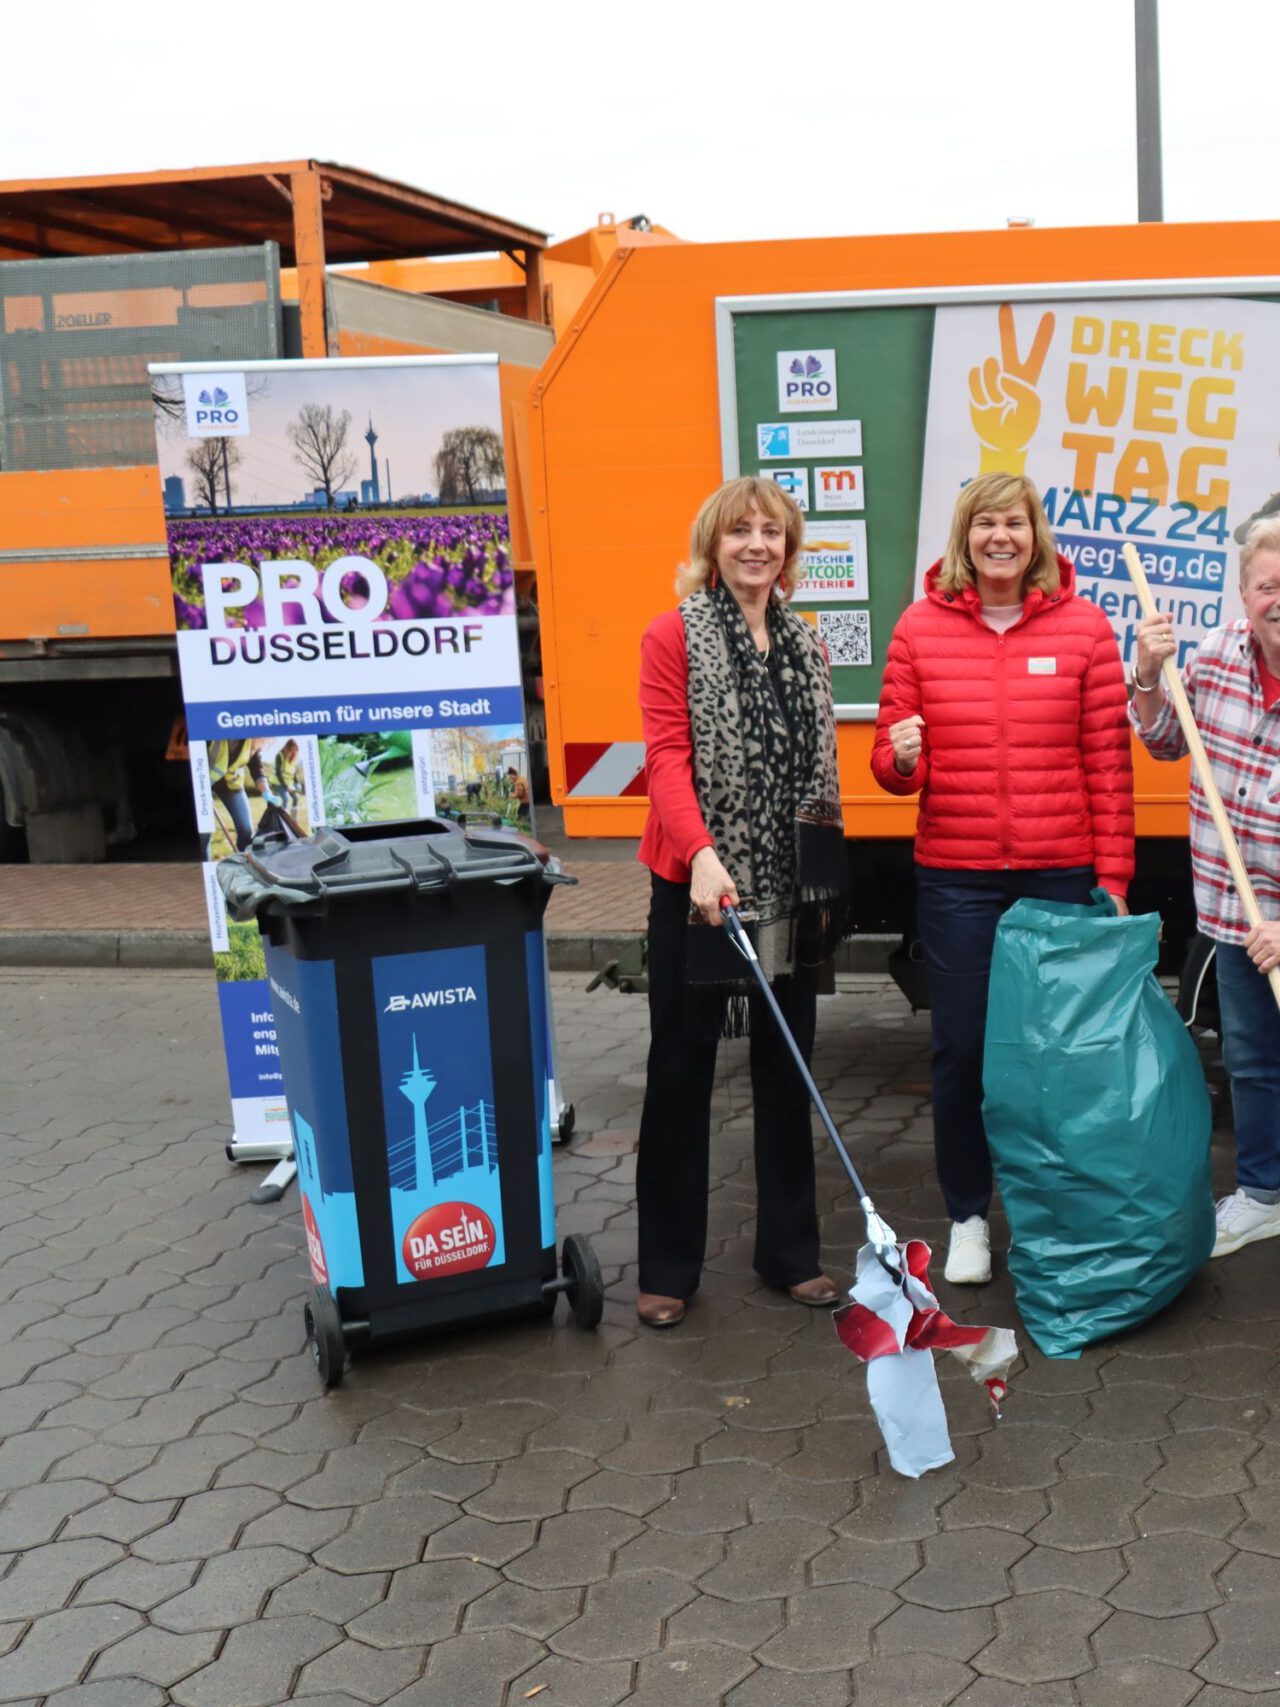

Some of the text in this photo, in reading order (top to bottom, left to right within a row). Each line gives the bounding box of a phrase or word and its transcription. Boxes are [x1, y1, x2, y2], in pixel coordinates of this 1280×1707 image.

[1071, 316, 1245, 371] DRECK
[786, 381, 832, 397] PRO
[1066, 362, 1237, 440] WEG
[196, 409, 239, 424] PRO
[1062, 431, 1230, 512] TAG
[1166, 500, 1230, 545] 24
[201, 556, 389, 629] PRO
[210, 625, 484, 666] DÜSSELDORF
[216, 699, 491, 728] Gemeinsam für unsere Stadt
[411, 986, 478, 1009] AWISTA
[410, 1208, 488, 1259] DA SEIN.
[415, 1242, 491, 1271] FÜR DÜSSELDORF.
